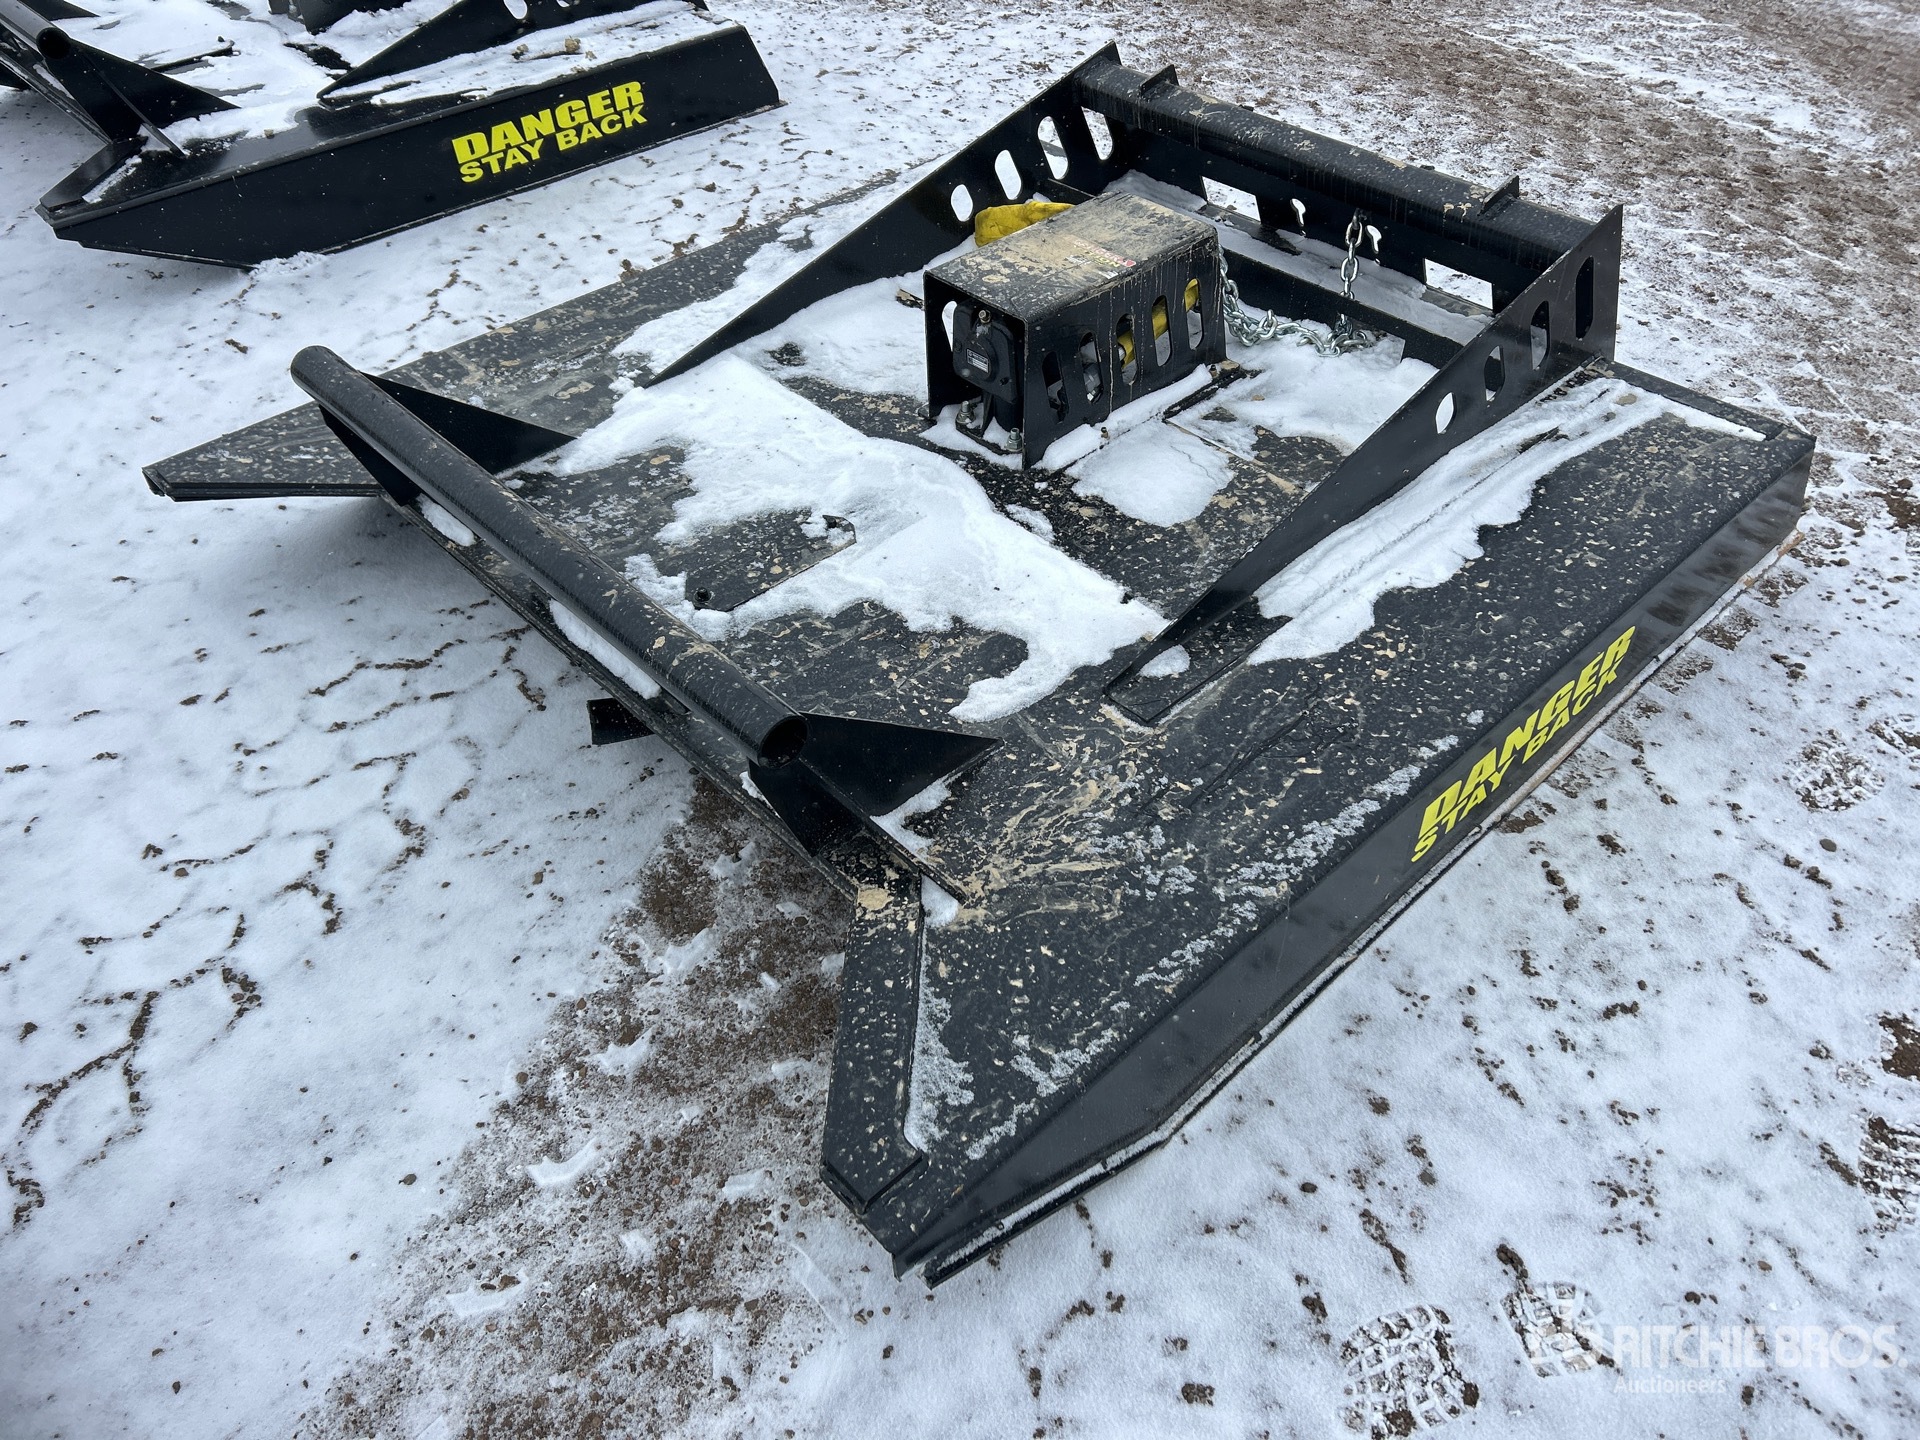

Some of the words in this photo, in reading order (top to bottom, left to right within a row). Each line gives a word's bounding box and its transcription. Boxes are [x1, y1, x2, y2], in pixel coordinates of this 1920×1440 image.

[452, 81, 645, 165] DANGER
[459, 138, 544, 183] STAY
[555, 104, 647, 151] BACK
[1411, 755, 1516, 862] STAY
[1522, 655, 1625, 764] BACK
[1418, 626, 1636, 840] DANGER
